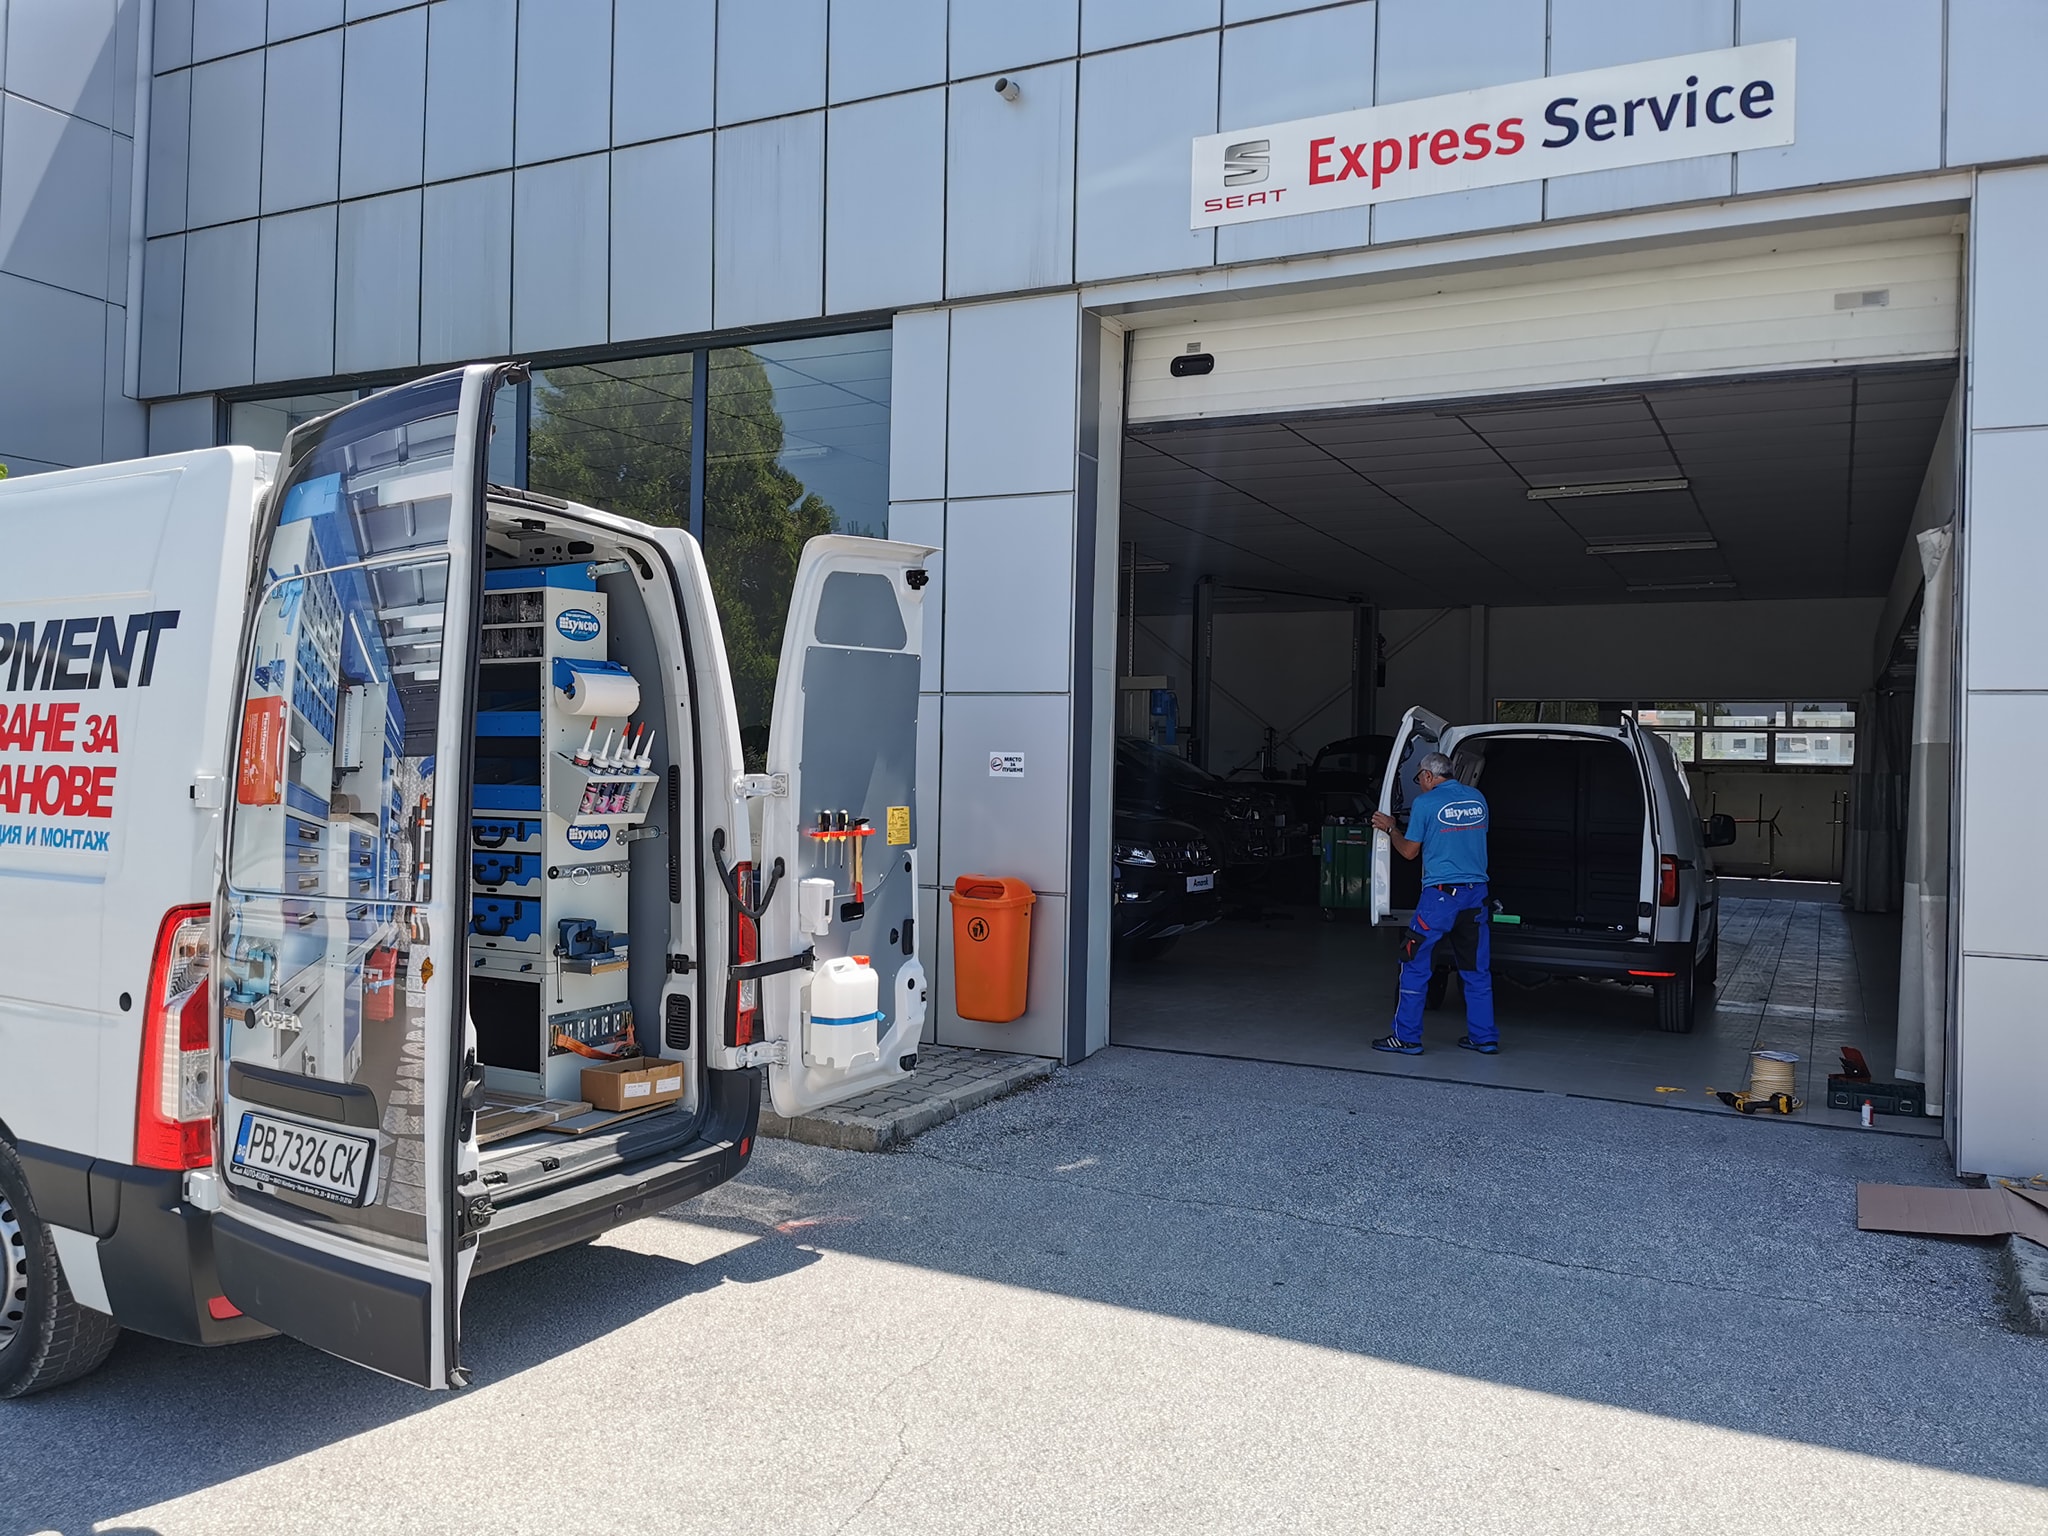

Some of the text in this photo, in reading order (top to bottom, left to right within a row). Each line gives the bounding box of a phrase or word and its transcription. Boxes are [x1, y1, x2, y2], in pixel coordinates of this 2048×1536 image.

[1309, 74, 1775, 189] Express Service
[1204, 188, 1288, 213] SEAT
[82, 714, 119, 753] ЗА
[25, 825, 37, 846] И
[40, 826, 111, 852] МОНТАЖ
[261, 1010, 303, 1031] OPEL
[237, 1143, 247, 1157] BG
